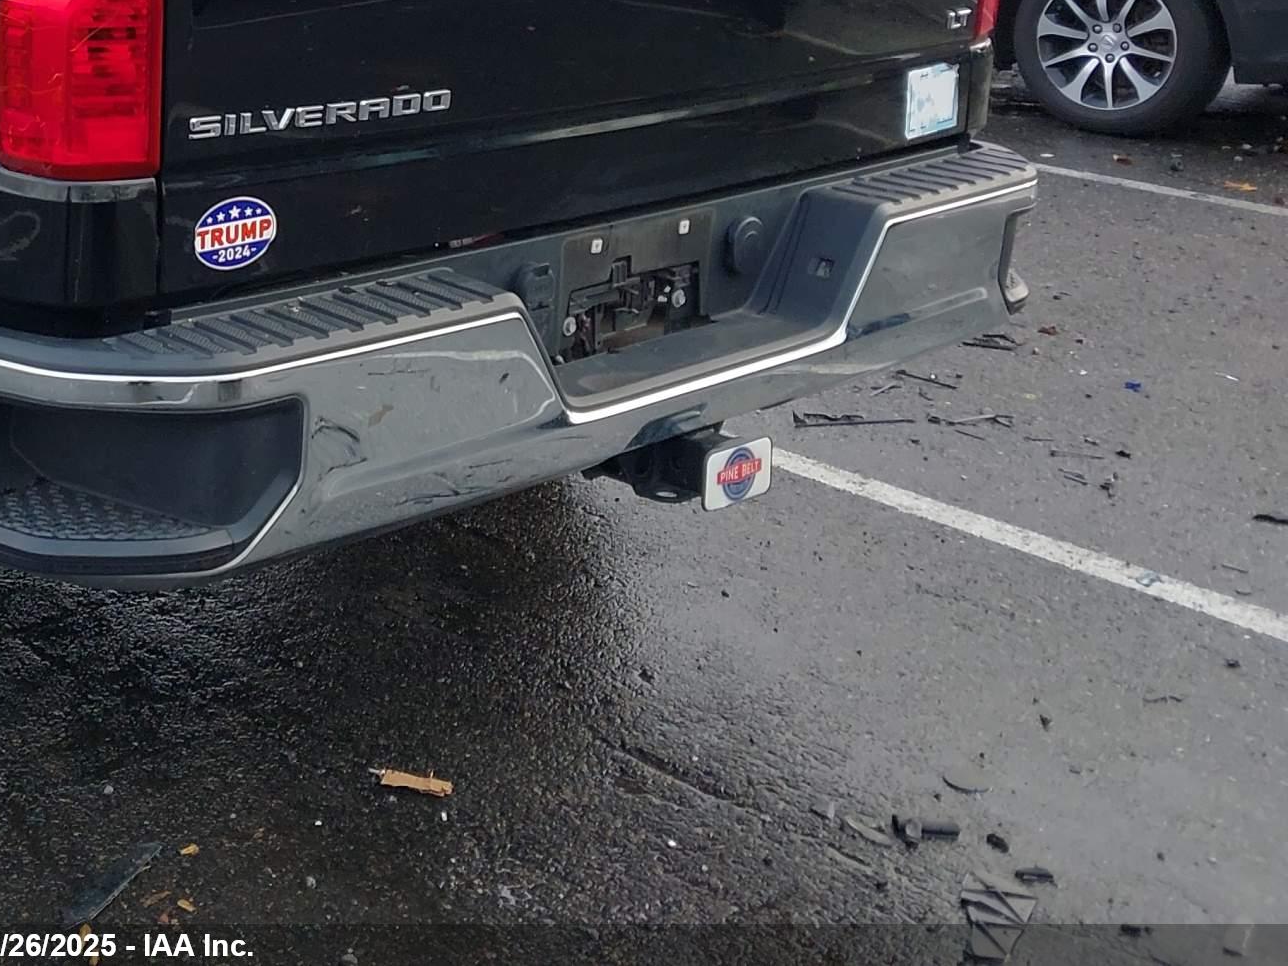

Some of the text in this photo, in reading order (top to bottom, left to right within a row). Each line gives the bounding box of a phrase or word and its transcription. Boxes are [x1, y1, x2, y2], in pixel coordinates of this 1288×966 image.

[947, 9, 972, 30] LT
[188, 89, 452, 140] SILVERADO
[196, 218, 272, 251] TRUMP
[720, 460, 759, 483] PINE BELT
